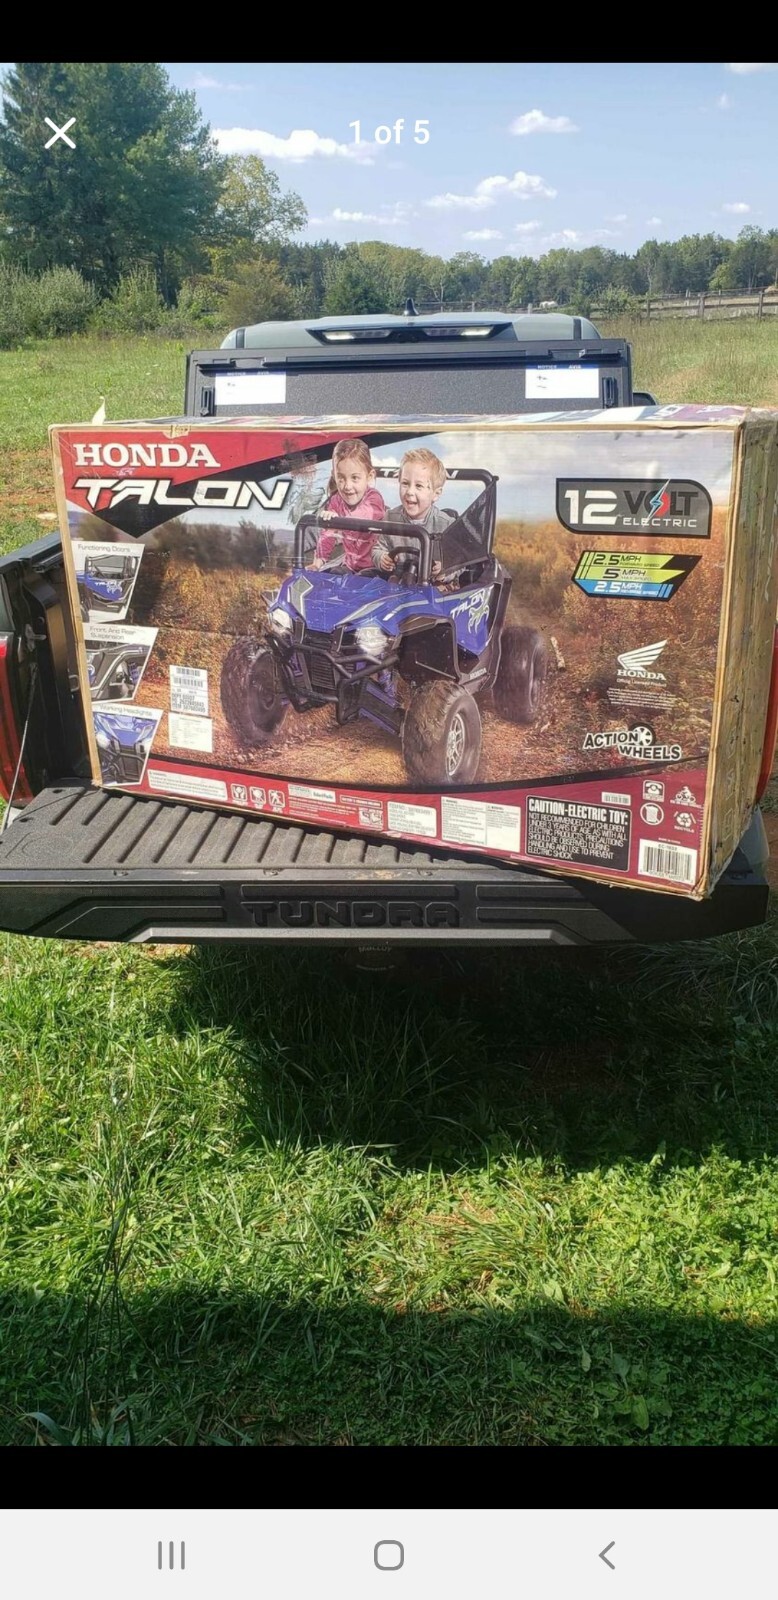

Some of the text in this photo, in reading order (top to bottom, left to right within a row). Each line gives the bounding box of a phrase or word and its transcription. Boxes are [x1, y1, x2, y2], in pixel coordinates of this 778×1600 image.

[72, 443, 221, 468] HONDA
[73, 478, 292, 510] TALON
[564, 489, 698, 526] 12 VOLT
[622, 517, 698, 528] ELECTRIC
[77, 543, 131, 553] Functioning Doors
[593, 554, 642, 566] 2.5 MPH
[602, 568, 621, 579] 5
[593, 580, 643, 593] 2.5 MPH
[450, 588, 486, 620] TALON
[90, 626, 108, 634] Front
[90, 632, 125, 641] Suspension
[617, 669, 667, 680] HONDA
[583, 733, 639, 749] ACTION
[618, 744, 682, 760] WHEELS
[528, 798, 607, 822] CAUTION-ELECTRIC
[609, 809, 629, 826] TOY:
[528, 812, 625, 833] NOT RECOMMENDED FOR CHILDREN
[528, 819, 547, 829] UNDER
[553, 821, 570, 831] YEARS
[570, 823, 578, 832] OF
[592, 827, 601, 836] AS
[601, 829, 616, 838] WITH
[616, 831, 628, 841] ALL
[528, 826, 553, 836] ELECTRIC
[585, 834, 624, 848] PRECAUTIONS
[528, 833, 610, 852] SHOULD BE OBSERVED DURING
[528, 840, 614, 860] HANDLING AND USE TO PREVENT
[528, 846, 553, 857] ELECTRIC
[241, 901, 461, 927] TUNDRA
